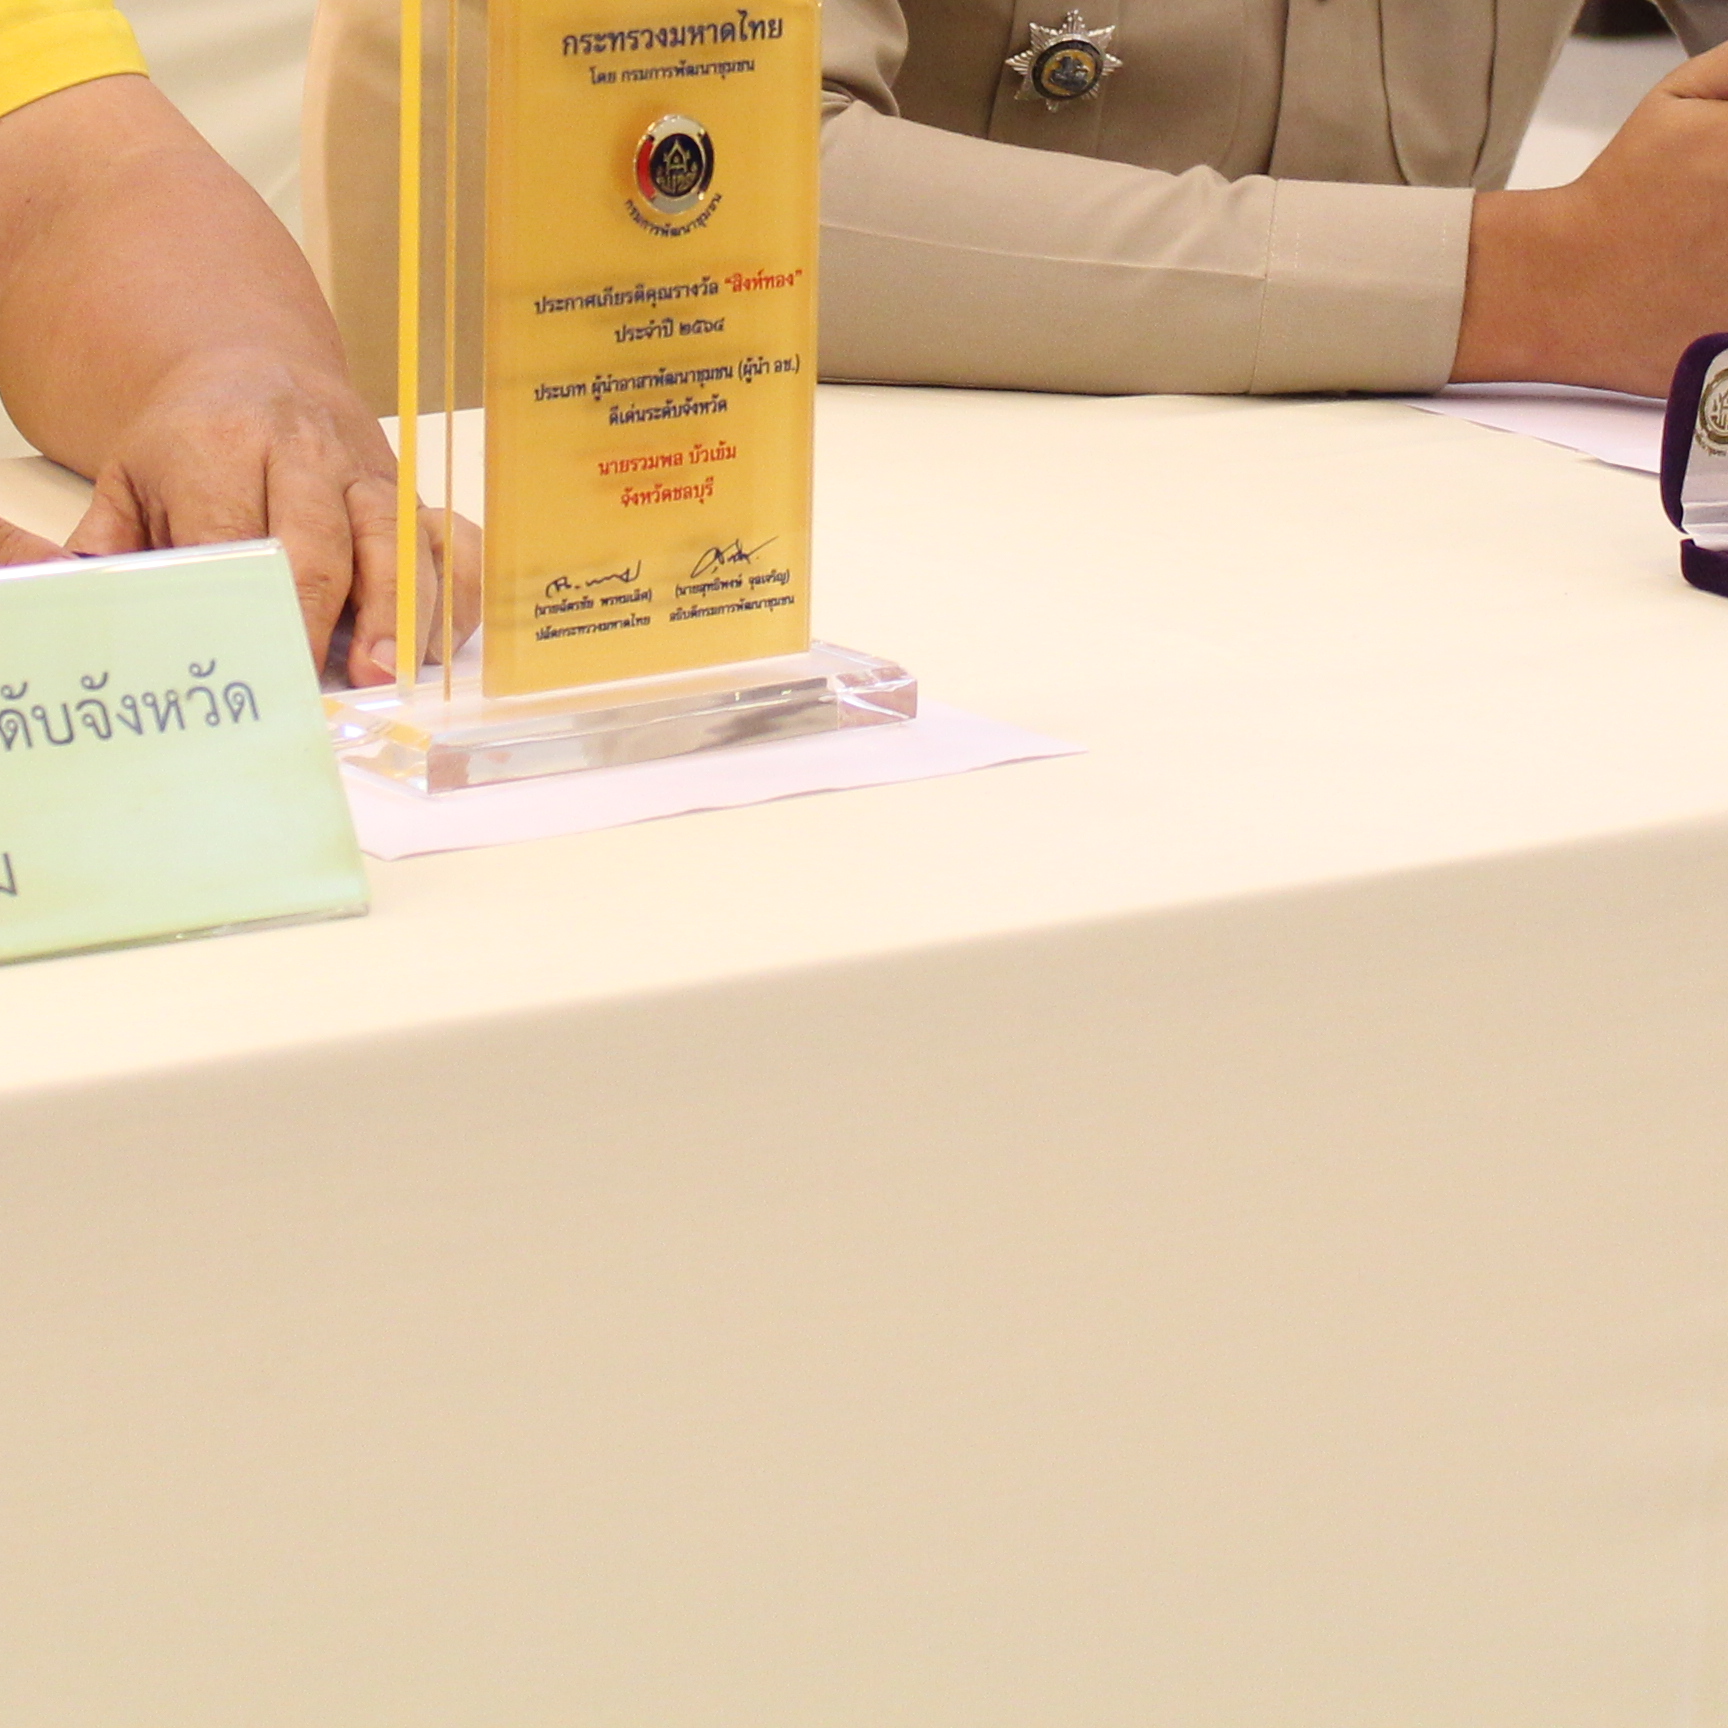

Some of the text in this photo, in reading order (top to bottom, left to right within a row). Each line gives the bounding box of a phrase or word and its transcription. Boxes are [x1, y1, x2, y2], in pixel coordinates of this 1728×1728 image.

[562, 9, 783, 57] กระทรวงมหาดไทย
[590, 59, 756, 85] โดย กรมการพัฒนาชุมชน
[535, 269, 802, 315] ประกาศเกียรติคุณรางวัล “สิงห์ทอง”
[615, 317, 673, 344] ประจำปี
[534, 354, 801, 402] ประเภท ผู้นำอาสาพัฒนาชุมชน (ผู้นำ อช.)
[609, 396, 728, 425] ดีเด่นระดับจังหวัด
[598, 440, 737, 476] นายรวมพล บัวเข้ม
[621, 476, 714, 508] จังหวัดชลบุรี
